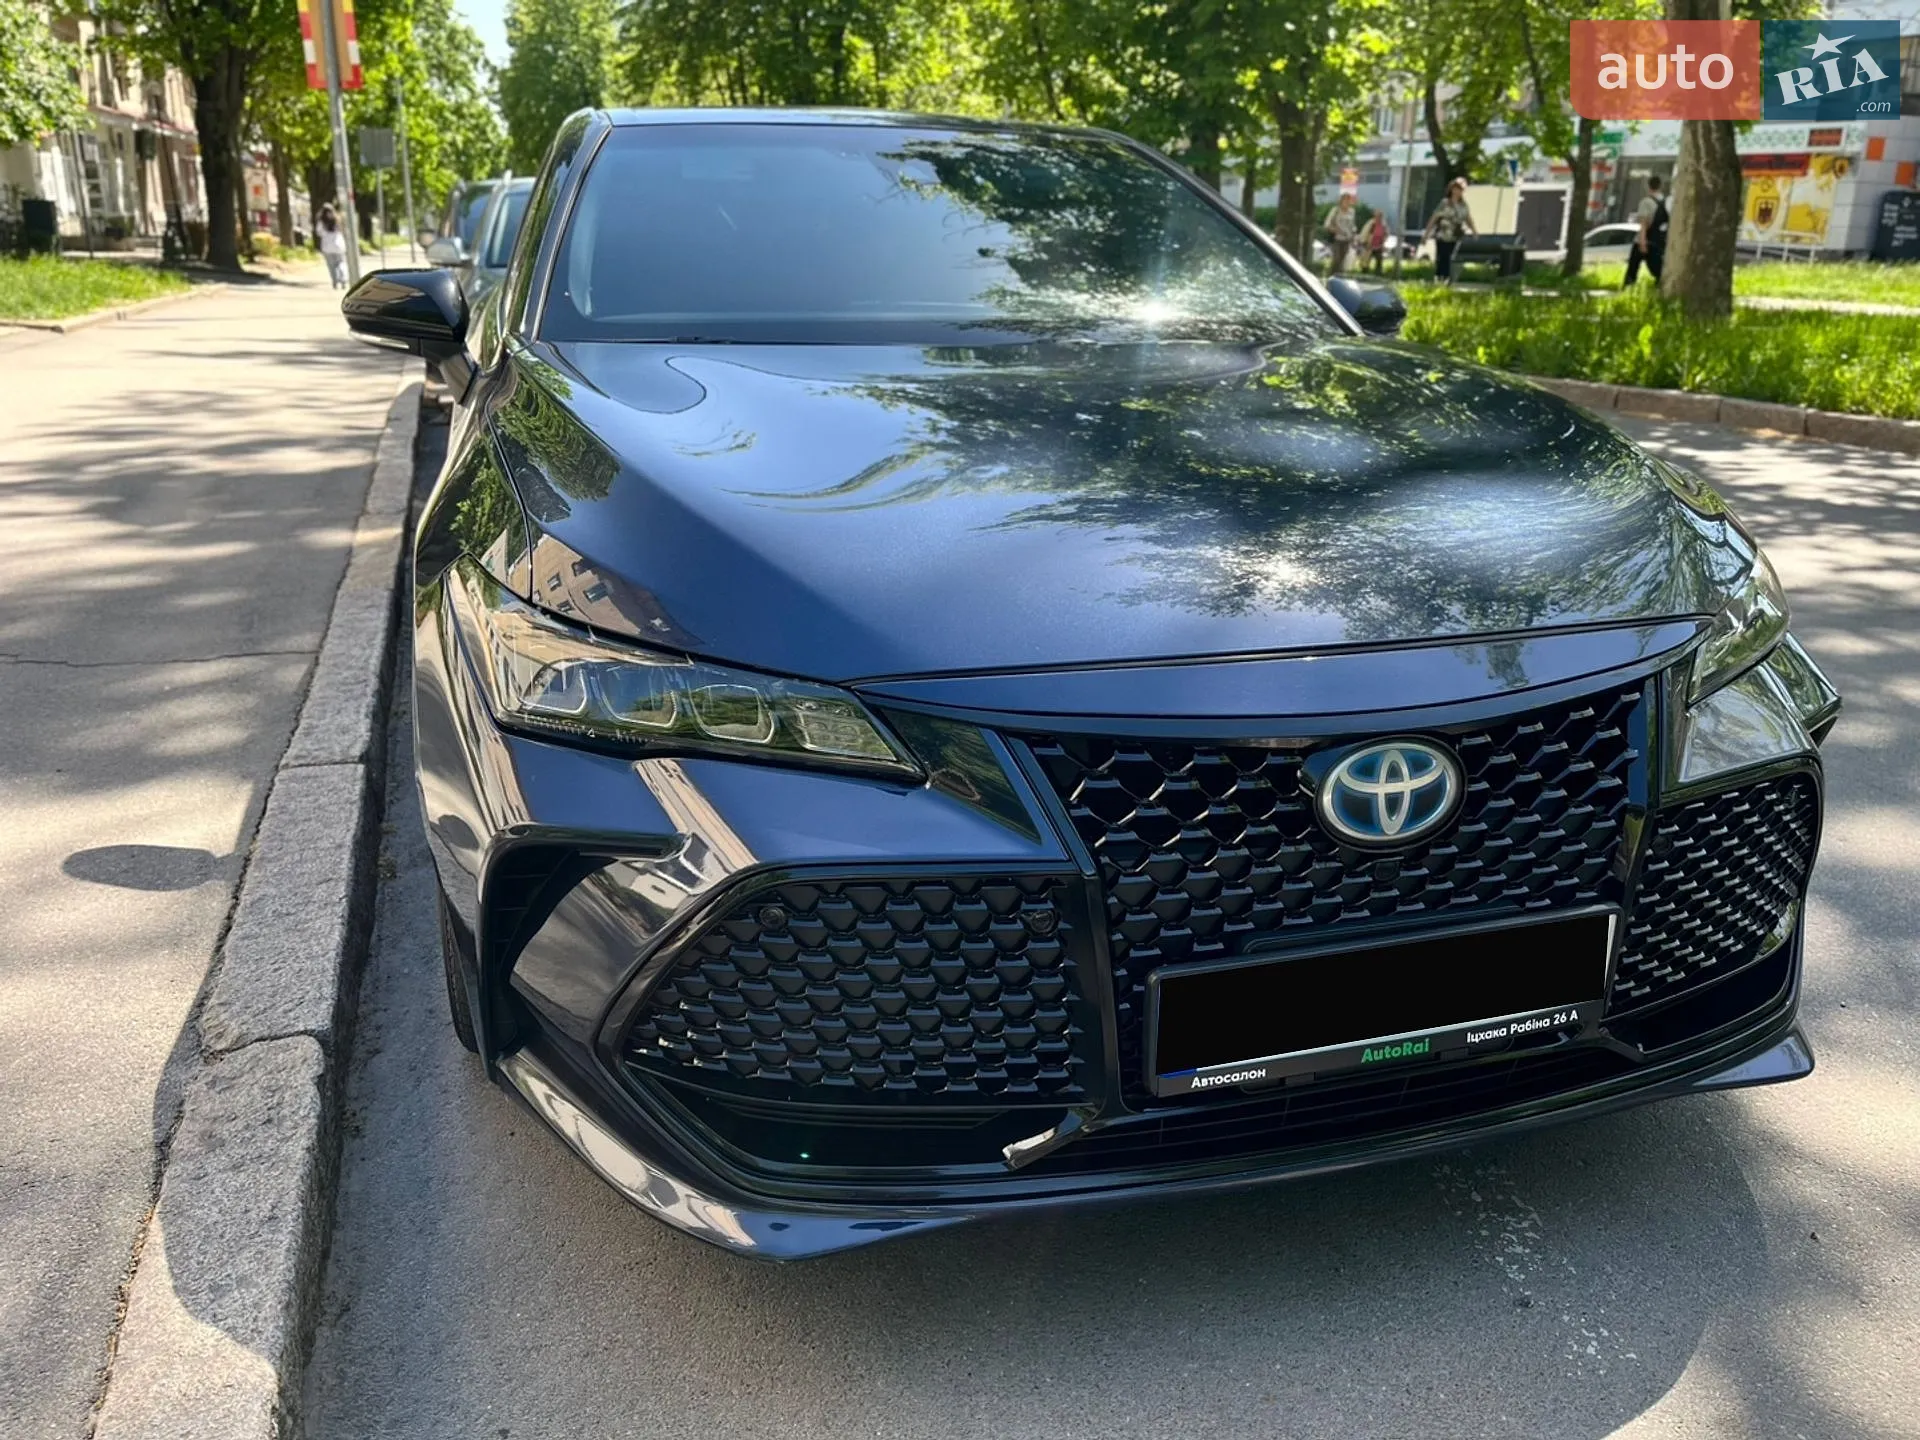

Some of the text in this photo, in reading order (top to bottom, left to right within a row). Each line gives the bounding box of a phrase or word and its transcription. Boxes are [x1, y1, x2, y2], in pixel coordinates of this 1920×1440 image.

[1467, 1027, 1507, 1044] Іцхака
[1510, 1018, 1550, 1035] Рабіна
[1553, 1012, 1568, 1025] 26
[1191, 1068, 1266, 1089] Автосалон
